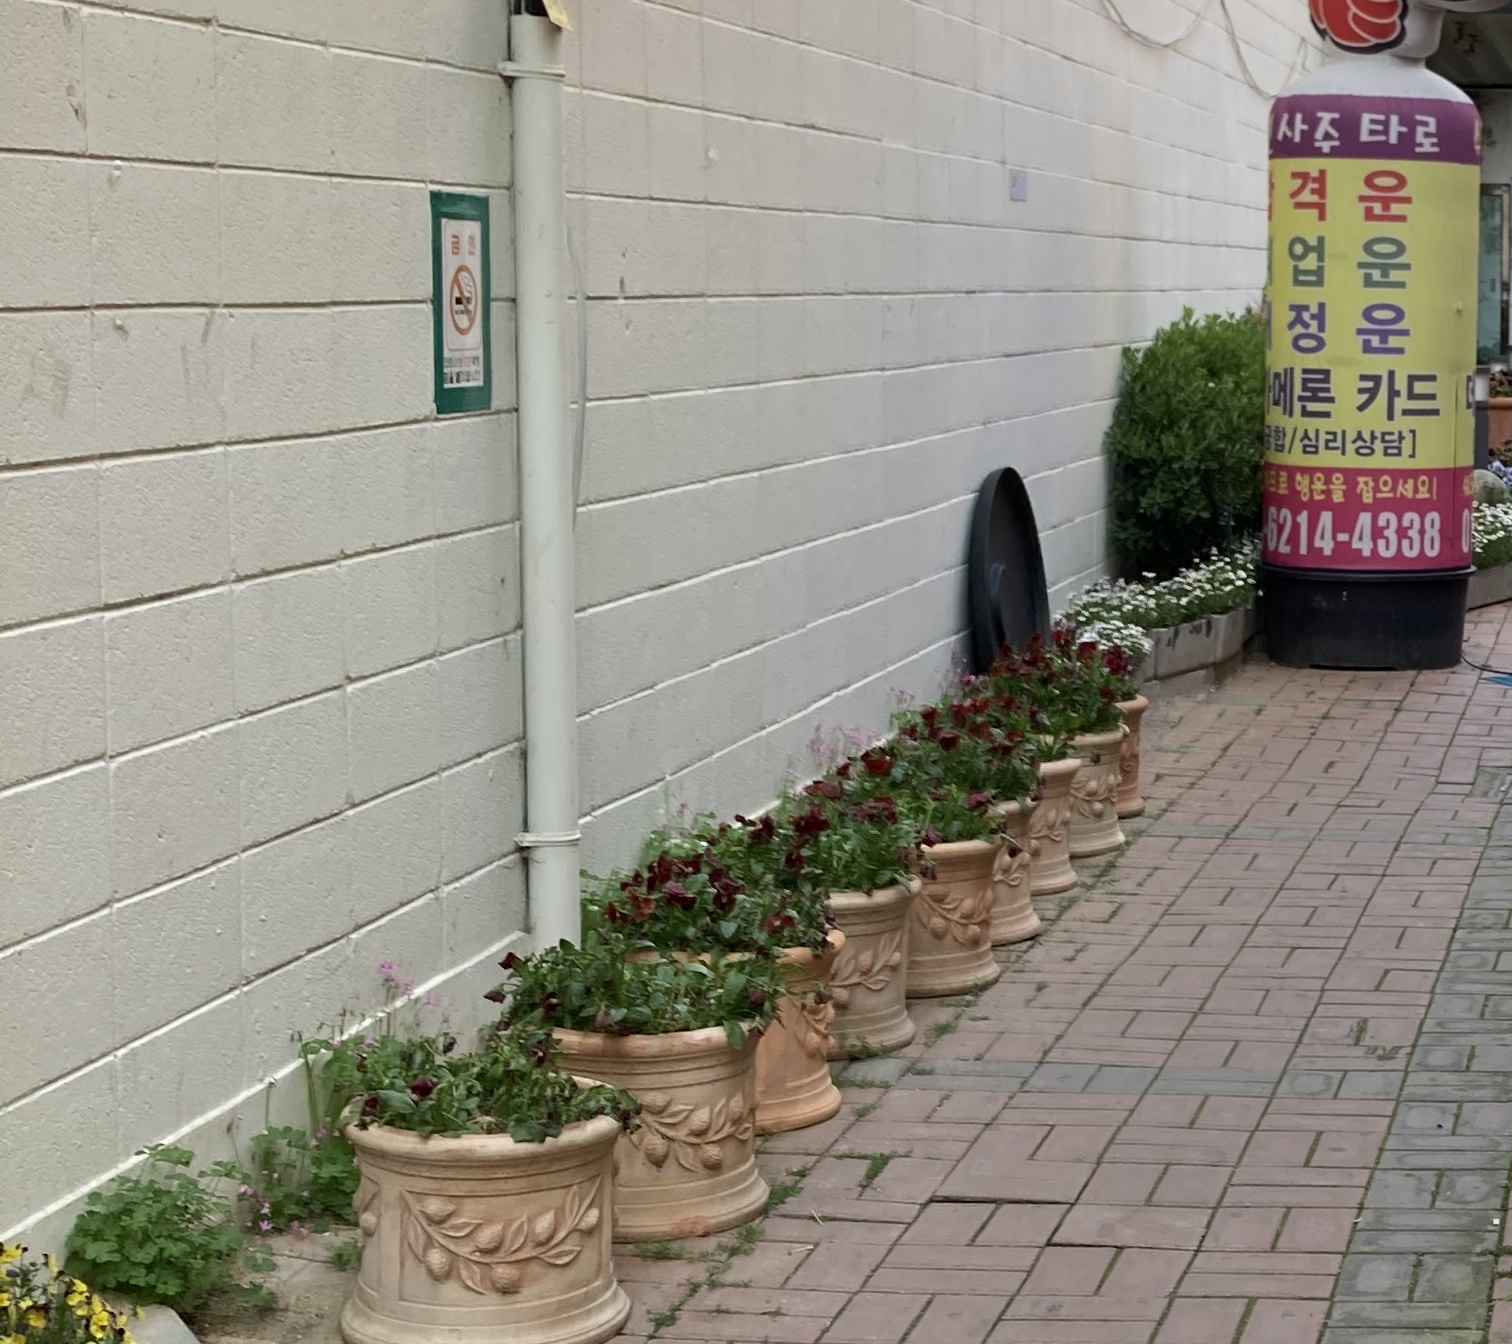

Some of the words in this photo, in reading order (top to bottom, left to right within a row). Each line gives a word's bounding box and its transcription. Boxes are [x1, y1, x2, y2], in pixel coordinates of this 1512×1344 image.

[1276, 111, 1341, 154] 사주
[1359, 112, 1441, 154] 타로
[1268, 168, 1413, 224] 격운
[1268, 235, 1412, 290] 업운
[1267, 301, 1411, 356] 정운
[1267, 367, 1336, 419] 메론
[1355, 369, 1441, 422] 카드
